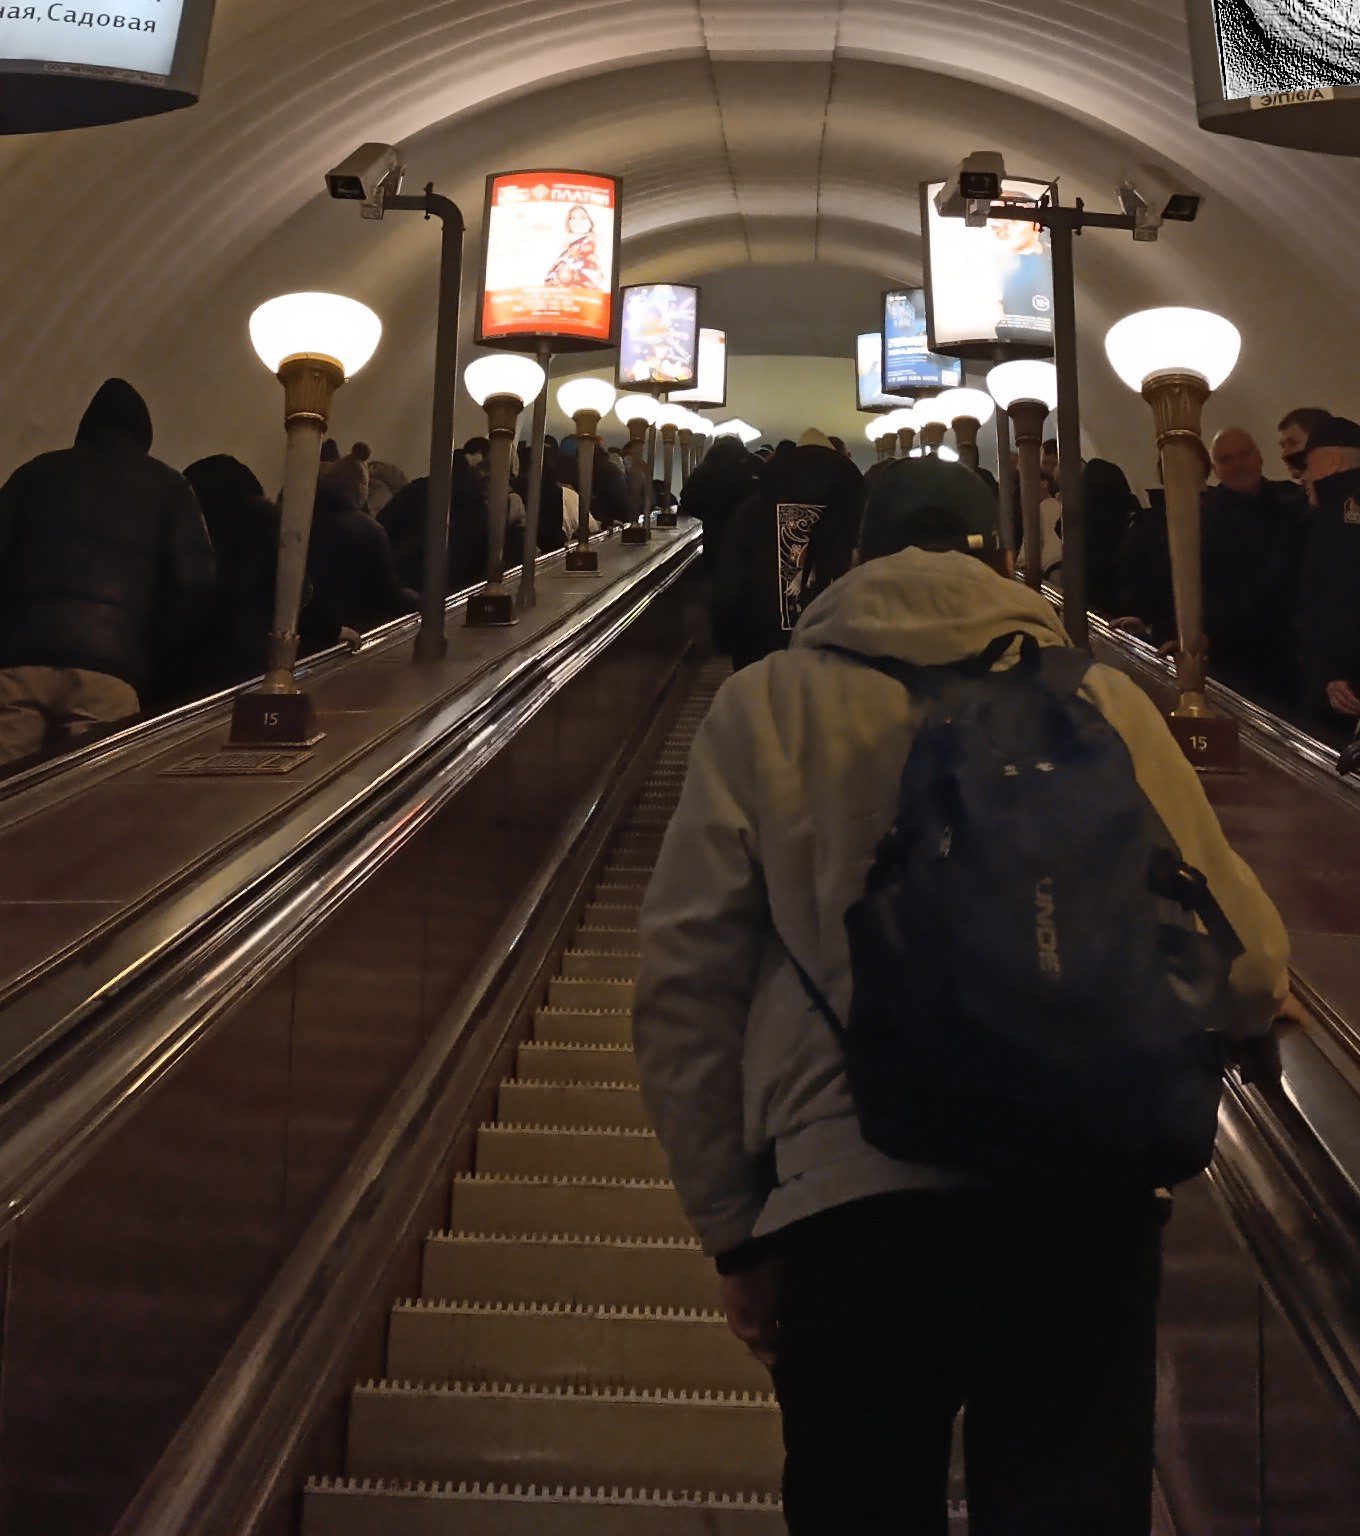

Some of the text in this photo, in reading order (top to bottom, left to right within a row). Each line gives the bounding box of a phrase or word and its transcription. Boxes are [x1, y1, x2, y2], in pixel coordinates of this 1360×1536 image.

[47, 2, 157, 34] Садовая
[263, 712, 280, 726] 15
[1189, 735, 1208, 751] 15
